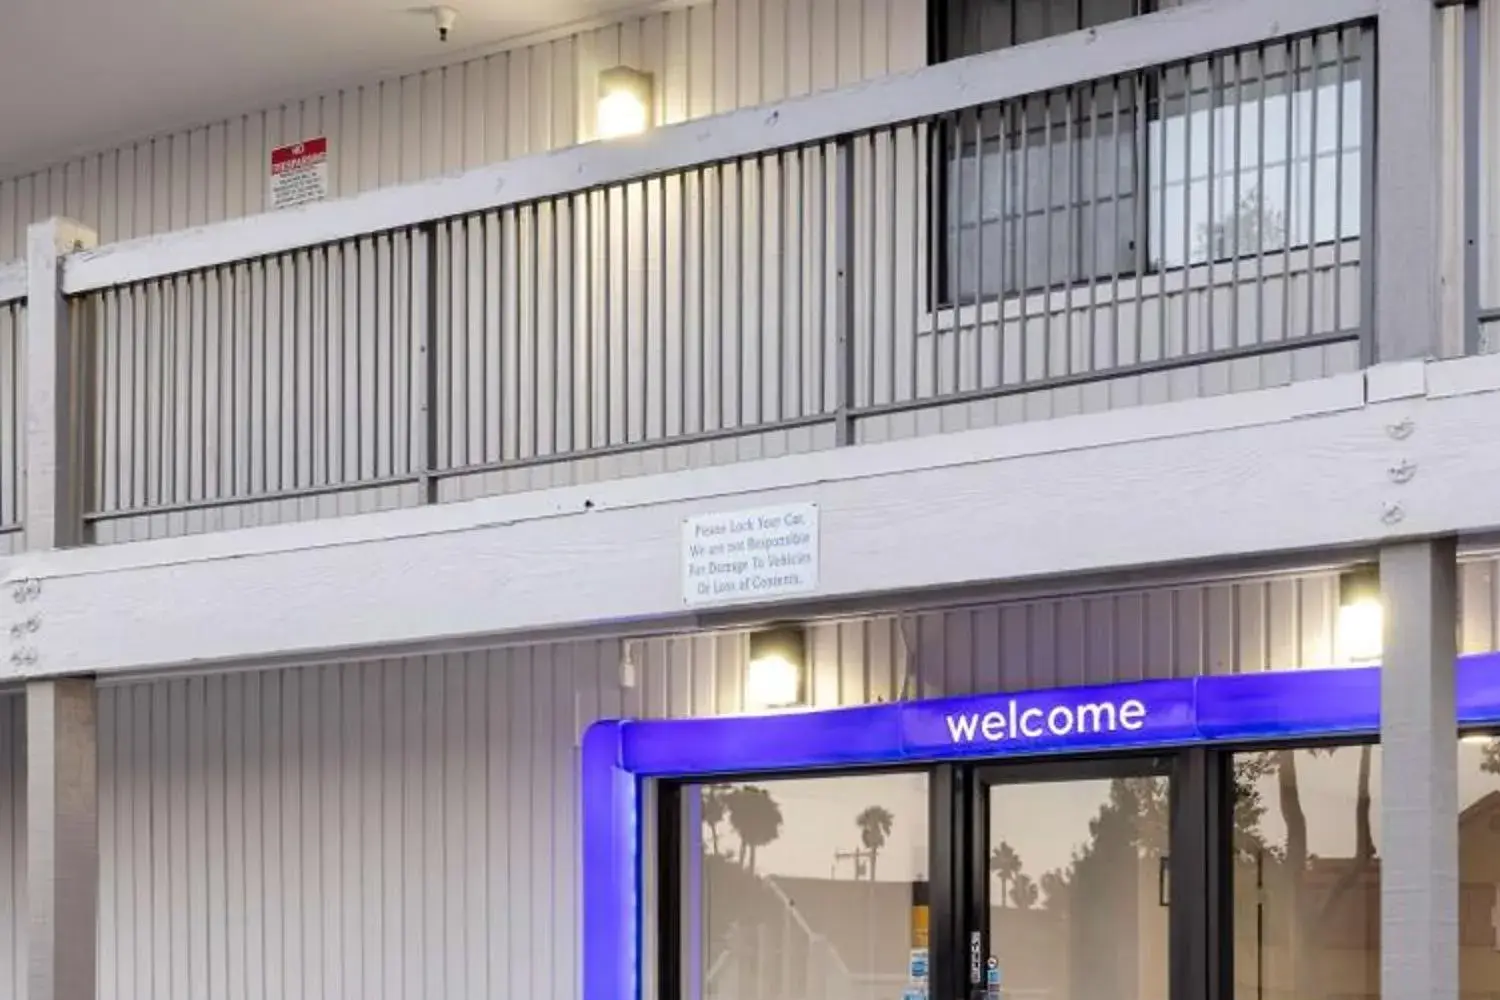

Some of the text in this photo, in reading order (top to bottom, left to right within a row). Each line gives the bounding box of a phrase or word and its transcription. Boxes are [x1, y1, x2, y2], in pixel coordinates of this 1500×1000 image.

[695, 523, 727, 538] Please
[730, 517, 755, 533] Lock
[758, 515, 781, 530] Your
[689, 533, 810, 558] We are not Responsible
[688, 551, 812, 578] For Damage To Vehicles
[697, 581, 710, 595] Or
[713, 579, 736, 594] Loss
[739, 578, 752, 591] of
[946, 699, 1146, 743] welcome
